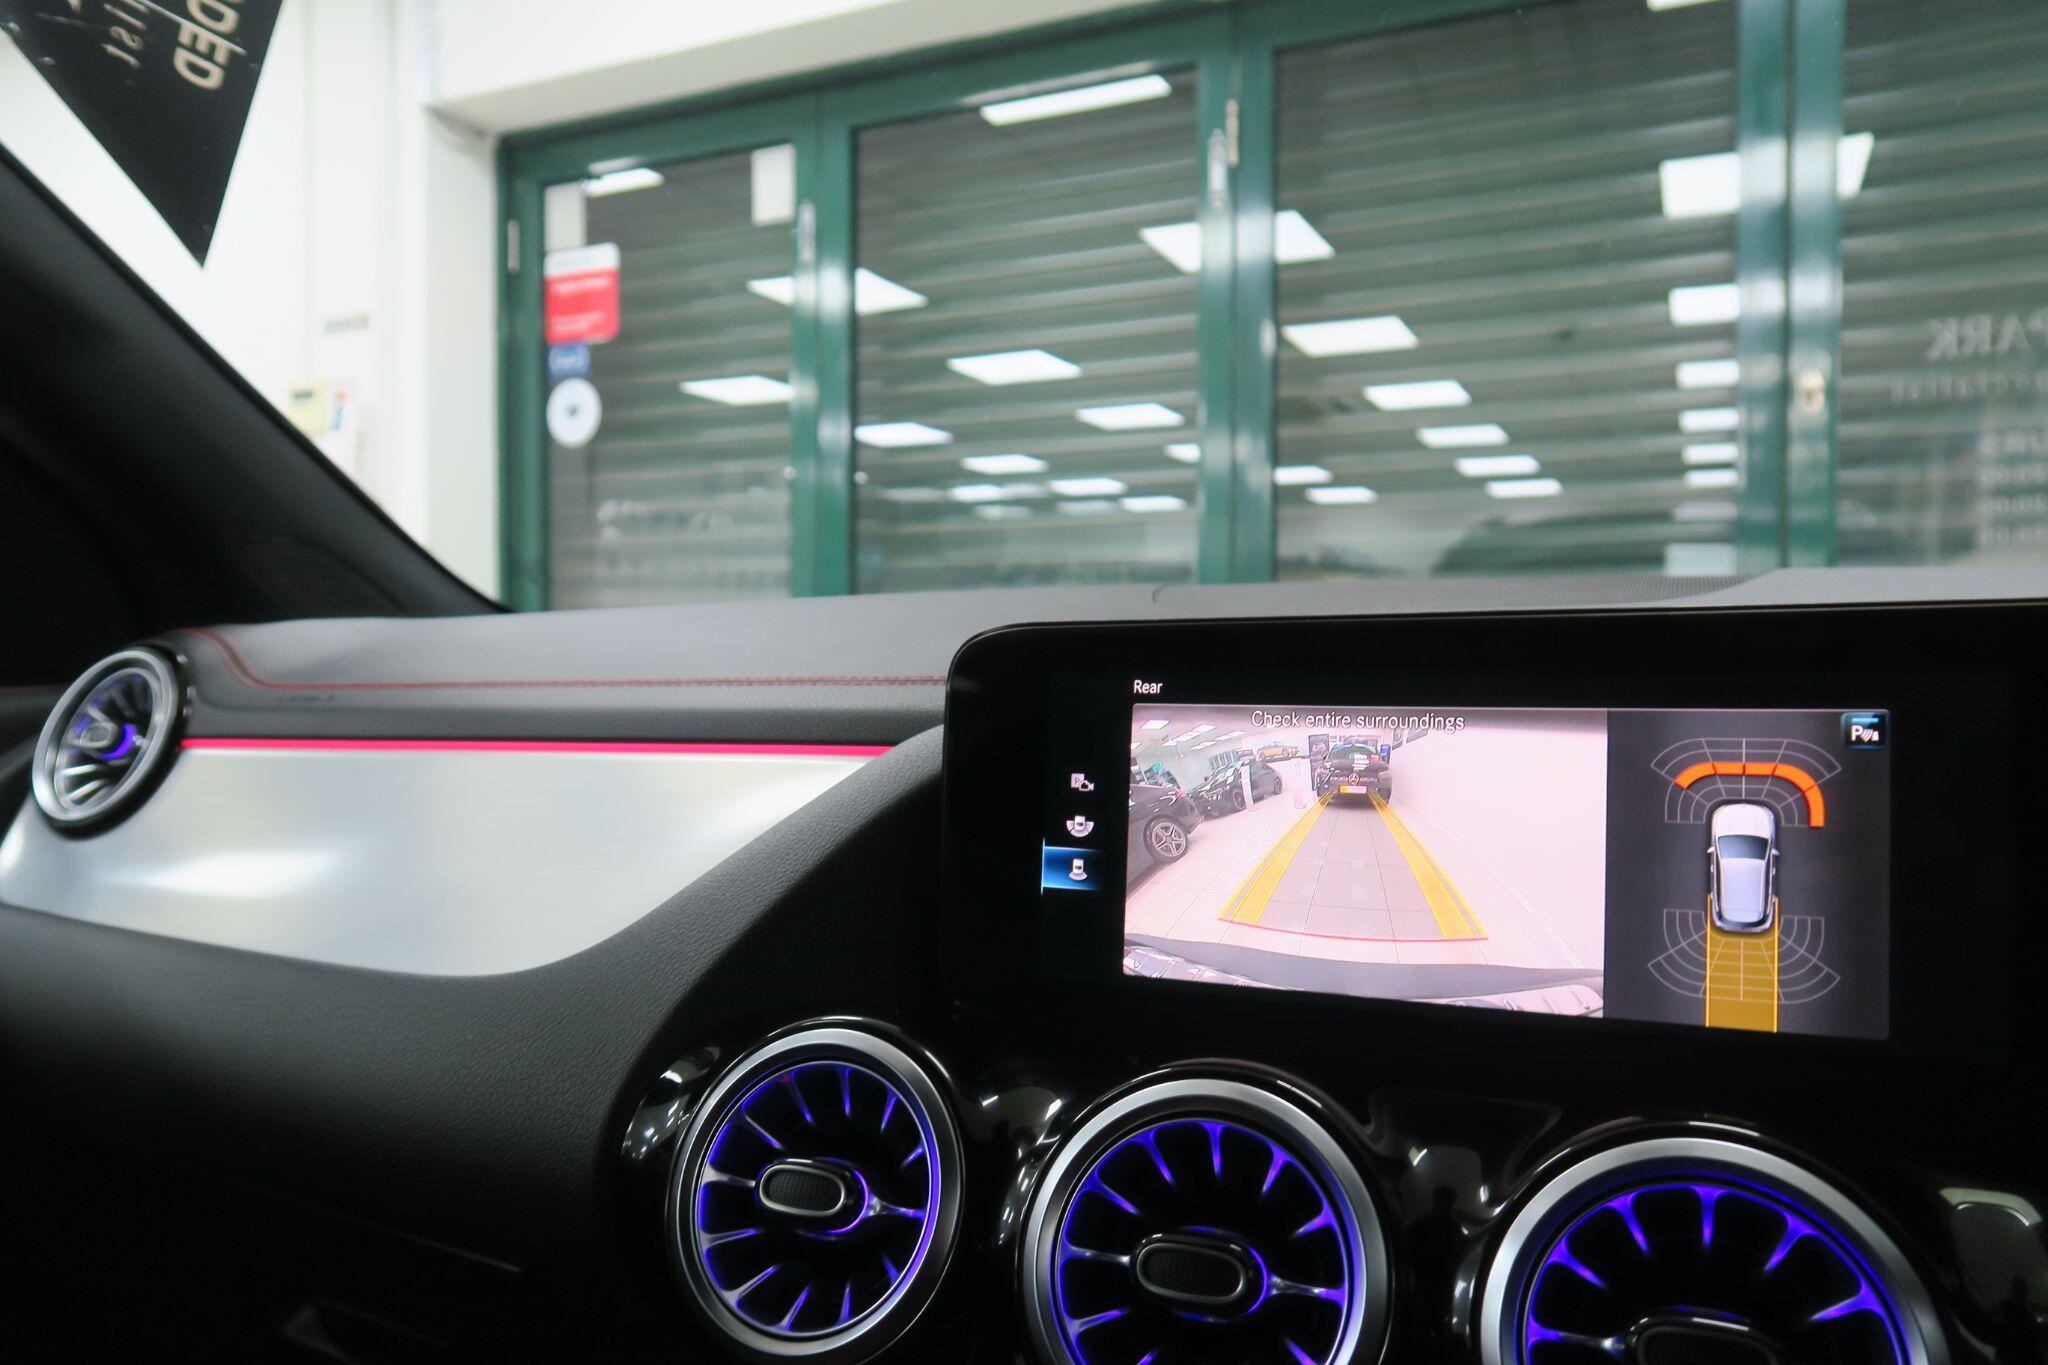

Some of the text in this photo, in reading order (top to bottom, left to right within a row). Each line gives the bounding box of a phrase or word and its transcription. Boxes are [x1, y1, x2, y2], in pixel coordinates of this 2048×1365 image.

[1132, 679, 1164, 695] Rear
[1251, 710, 1465, 734] Check entire surroundings
